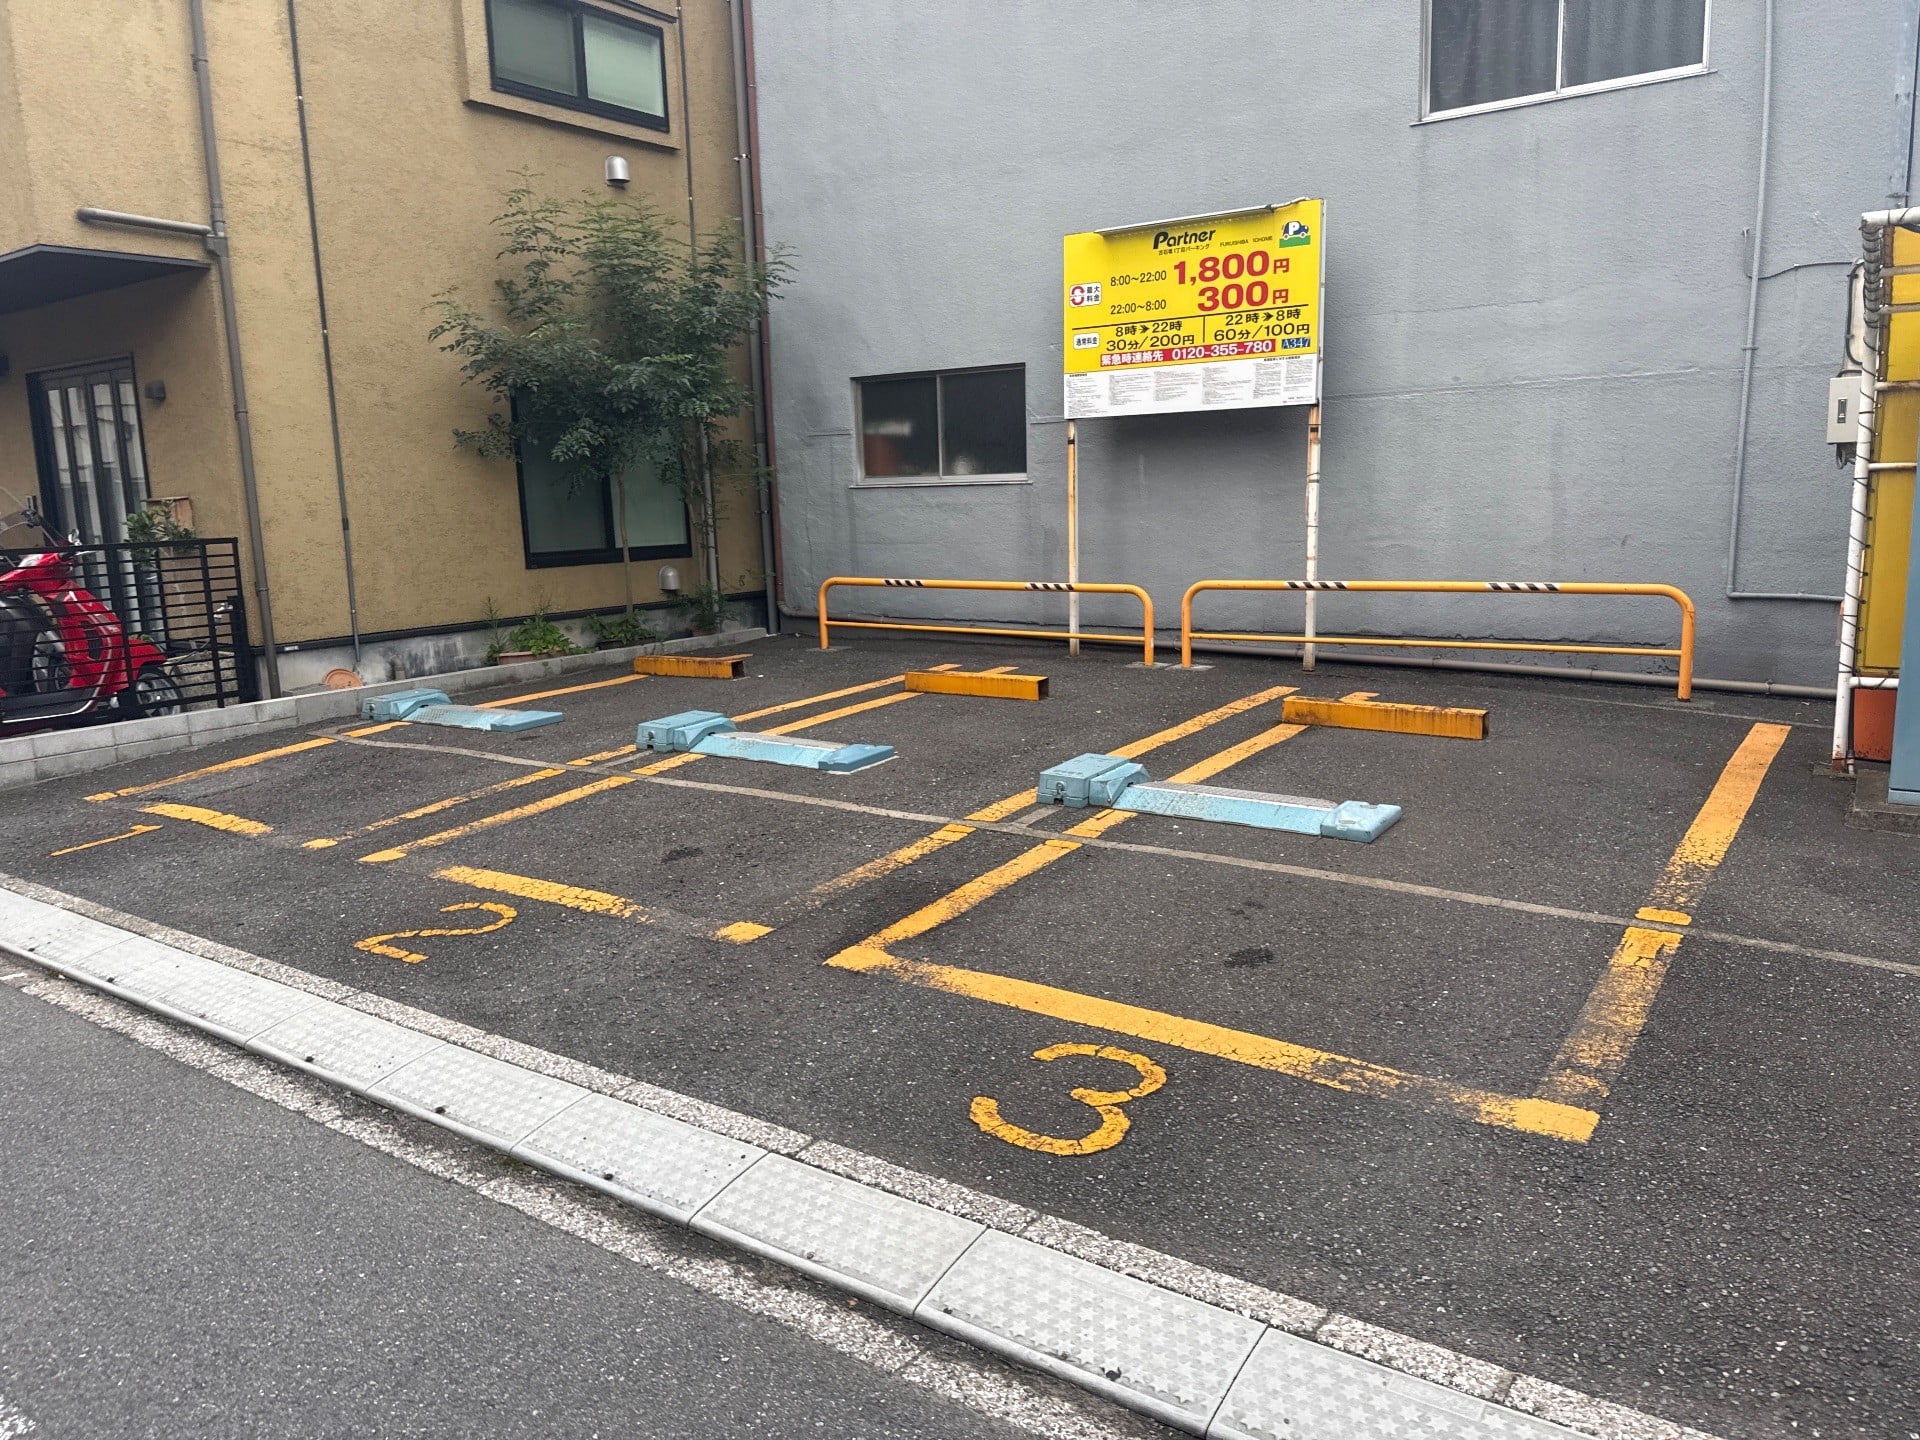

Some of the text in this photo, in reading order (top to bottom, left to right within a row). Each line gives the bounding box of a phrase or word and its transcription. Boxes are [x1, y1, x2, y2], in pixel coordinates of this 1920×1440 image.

[1153, 229, 1216, 249] Partner
[1173, 250, 1290, 285] 1,800円
[1197, 281, 1289, 312] 300円
[1101, 341, 1272, 366] 緊急時連絡先 0120-355-780
[1282, 338, 1310, 349] A347
[354, 900, 520, 965] 2
[968, 1041, 1168, 1157] 3
